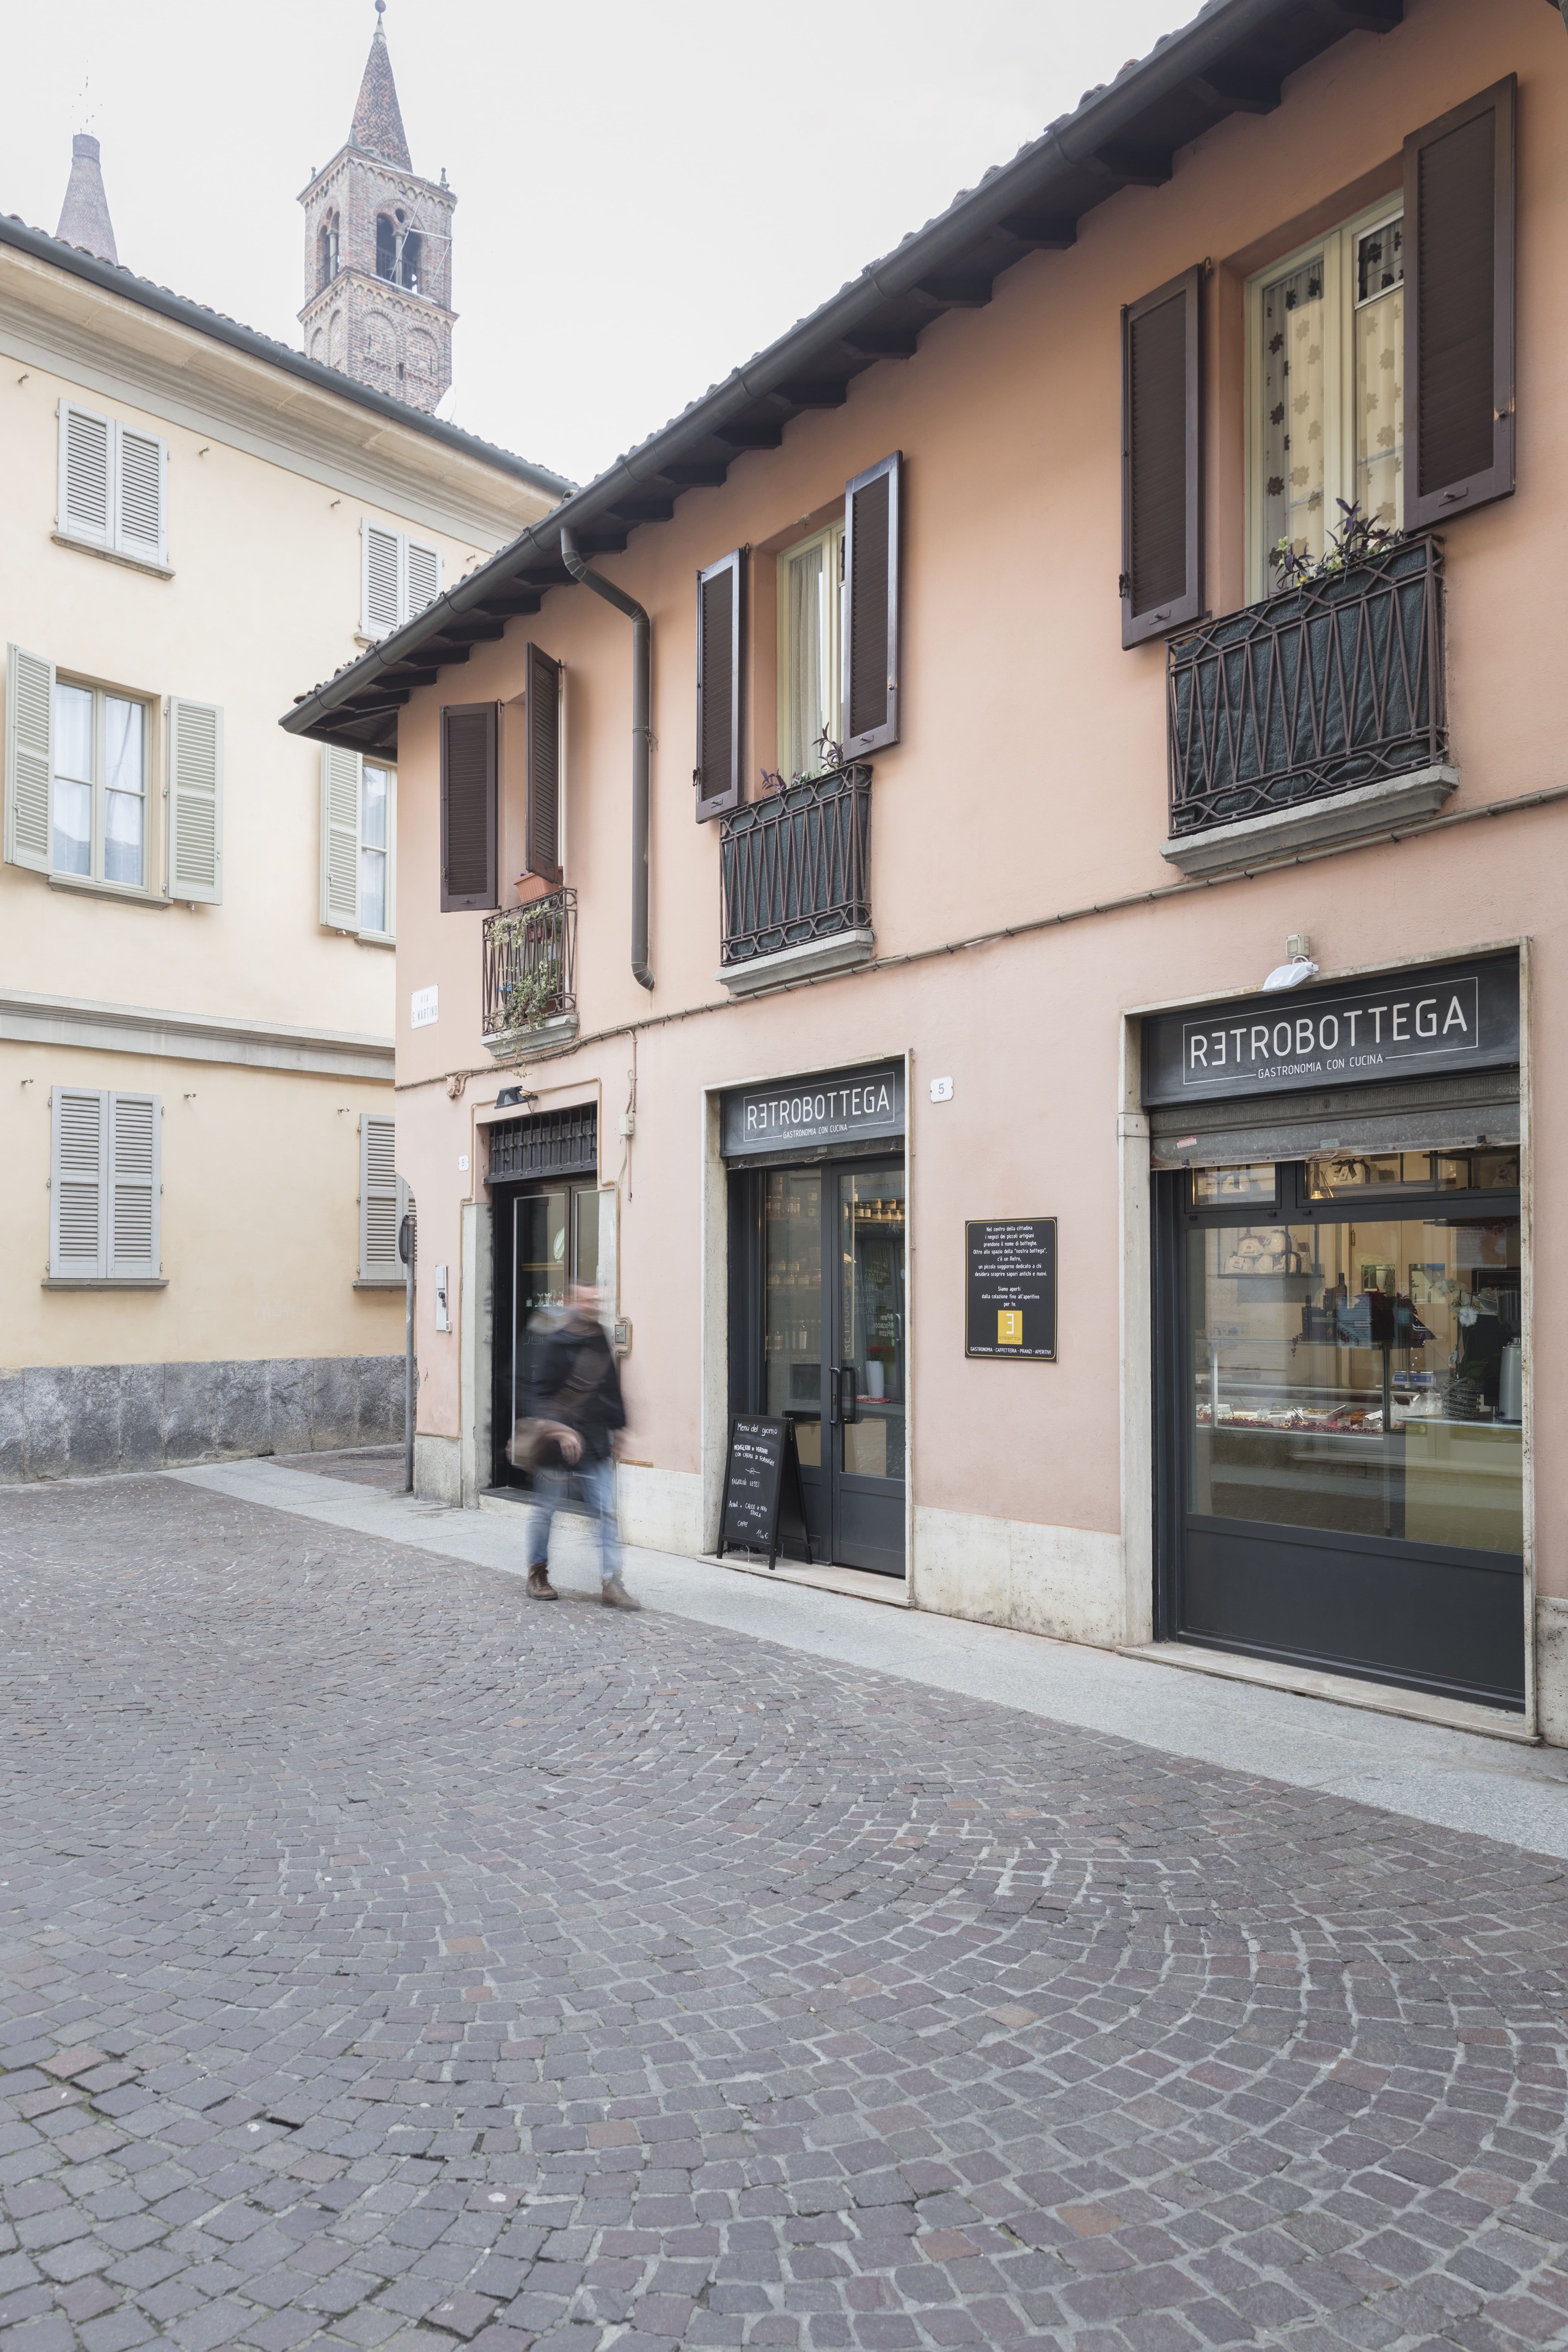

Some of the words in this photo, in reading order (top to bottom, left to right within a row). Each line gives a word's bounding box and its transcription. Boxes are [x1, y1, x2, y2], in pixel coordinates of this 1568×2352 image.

[420, 994, 428, 1003] VIA
[417, 1005, 437, 1021] MARTINO
[1258, 1061, 1322, 1079] GASTRONOMIA
[1327, 1057, 1345, 1070] CON
[1349, 1053, 1383, 1068] CUCINA
[938, 1083, 945, 1095] 5
[783, 1128, 817, 1139] GASTRONOMIA
[818, 1126, 828, 1135] CON
[830, 1124, 848, 1133] CUCINA
[751, 1424, 759, 1432] del
[761, 1428, 778, 1436] giorno
[756, 1447, 769, 1455] VERDURE
